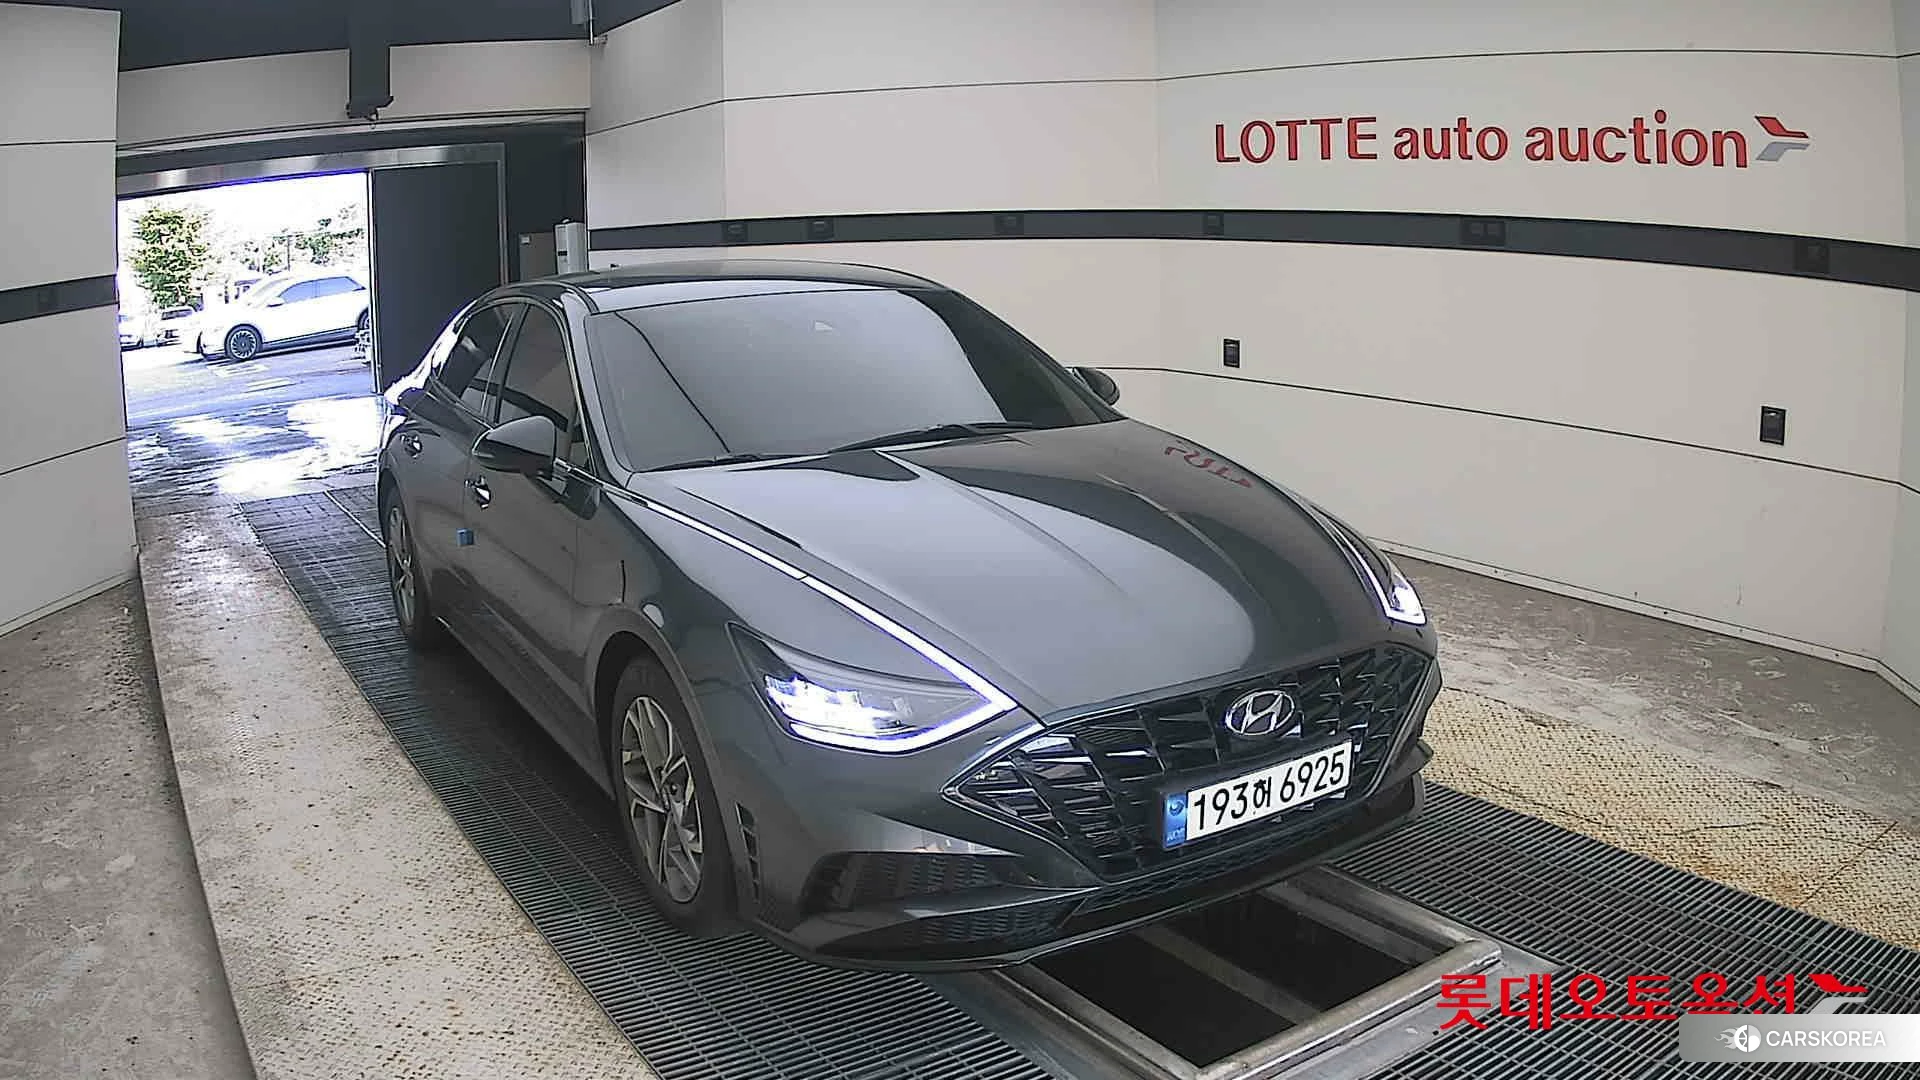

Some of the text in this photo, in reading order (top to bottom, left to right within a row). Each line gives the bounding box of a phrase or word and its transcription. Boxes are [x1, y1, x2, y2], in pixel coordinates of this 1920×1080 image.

[1215, 110, 1748, 168] LOTTE auto auction
[1193, 750, 1345, 830] 193허 6925
